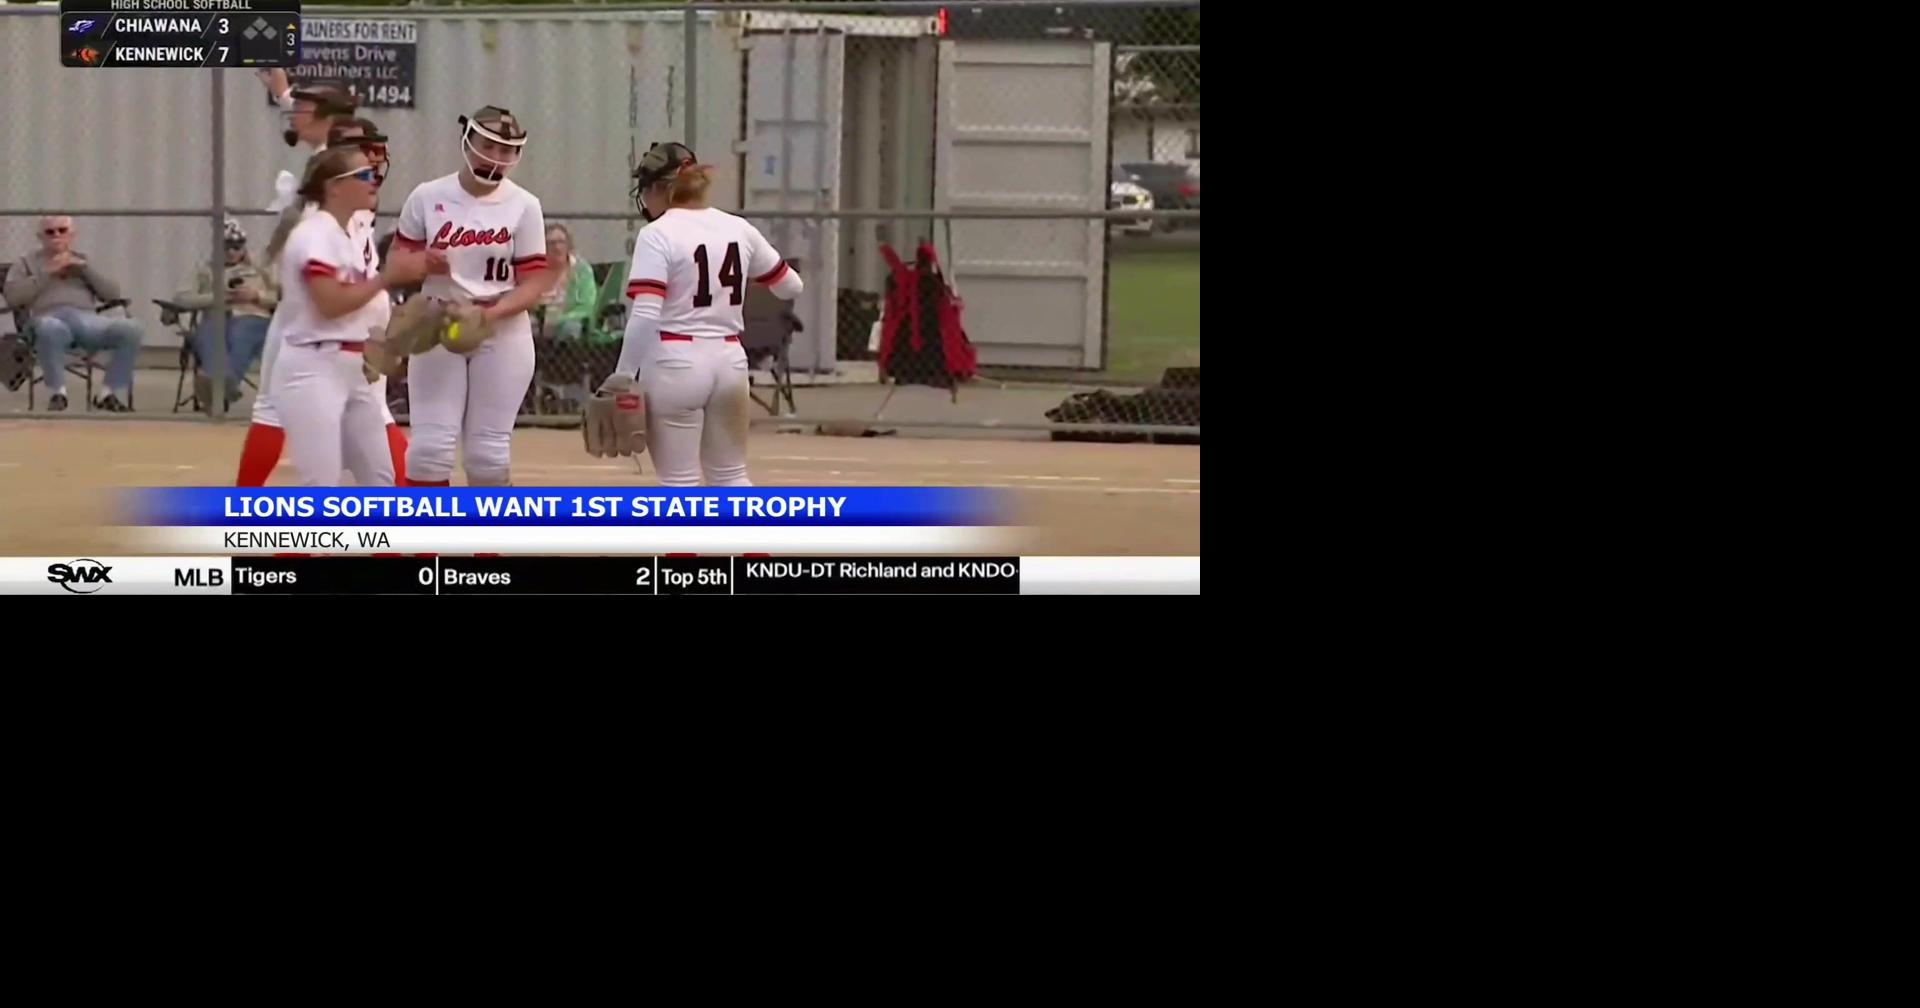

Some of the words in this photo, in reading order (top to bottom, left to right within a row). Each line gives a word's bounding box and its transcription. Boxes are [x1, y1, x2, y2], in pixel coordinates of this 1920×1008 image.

[302, 22, 350, 38] AINERS
[355, 22, 378, 38] FOR
[382, 22, 414, 39] RENT
[302, 46, 350, 60] evens
[355, 45, 397, 61] Drive
[376, 66, 398, 79] LLC
[348, 84, 411, 103] 1-1494
[430, 221, 512, 250] Lions
[483, 257, 509, 281] 10
[693, 242, 743, 308] 14
